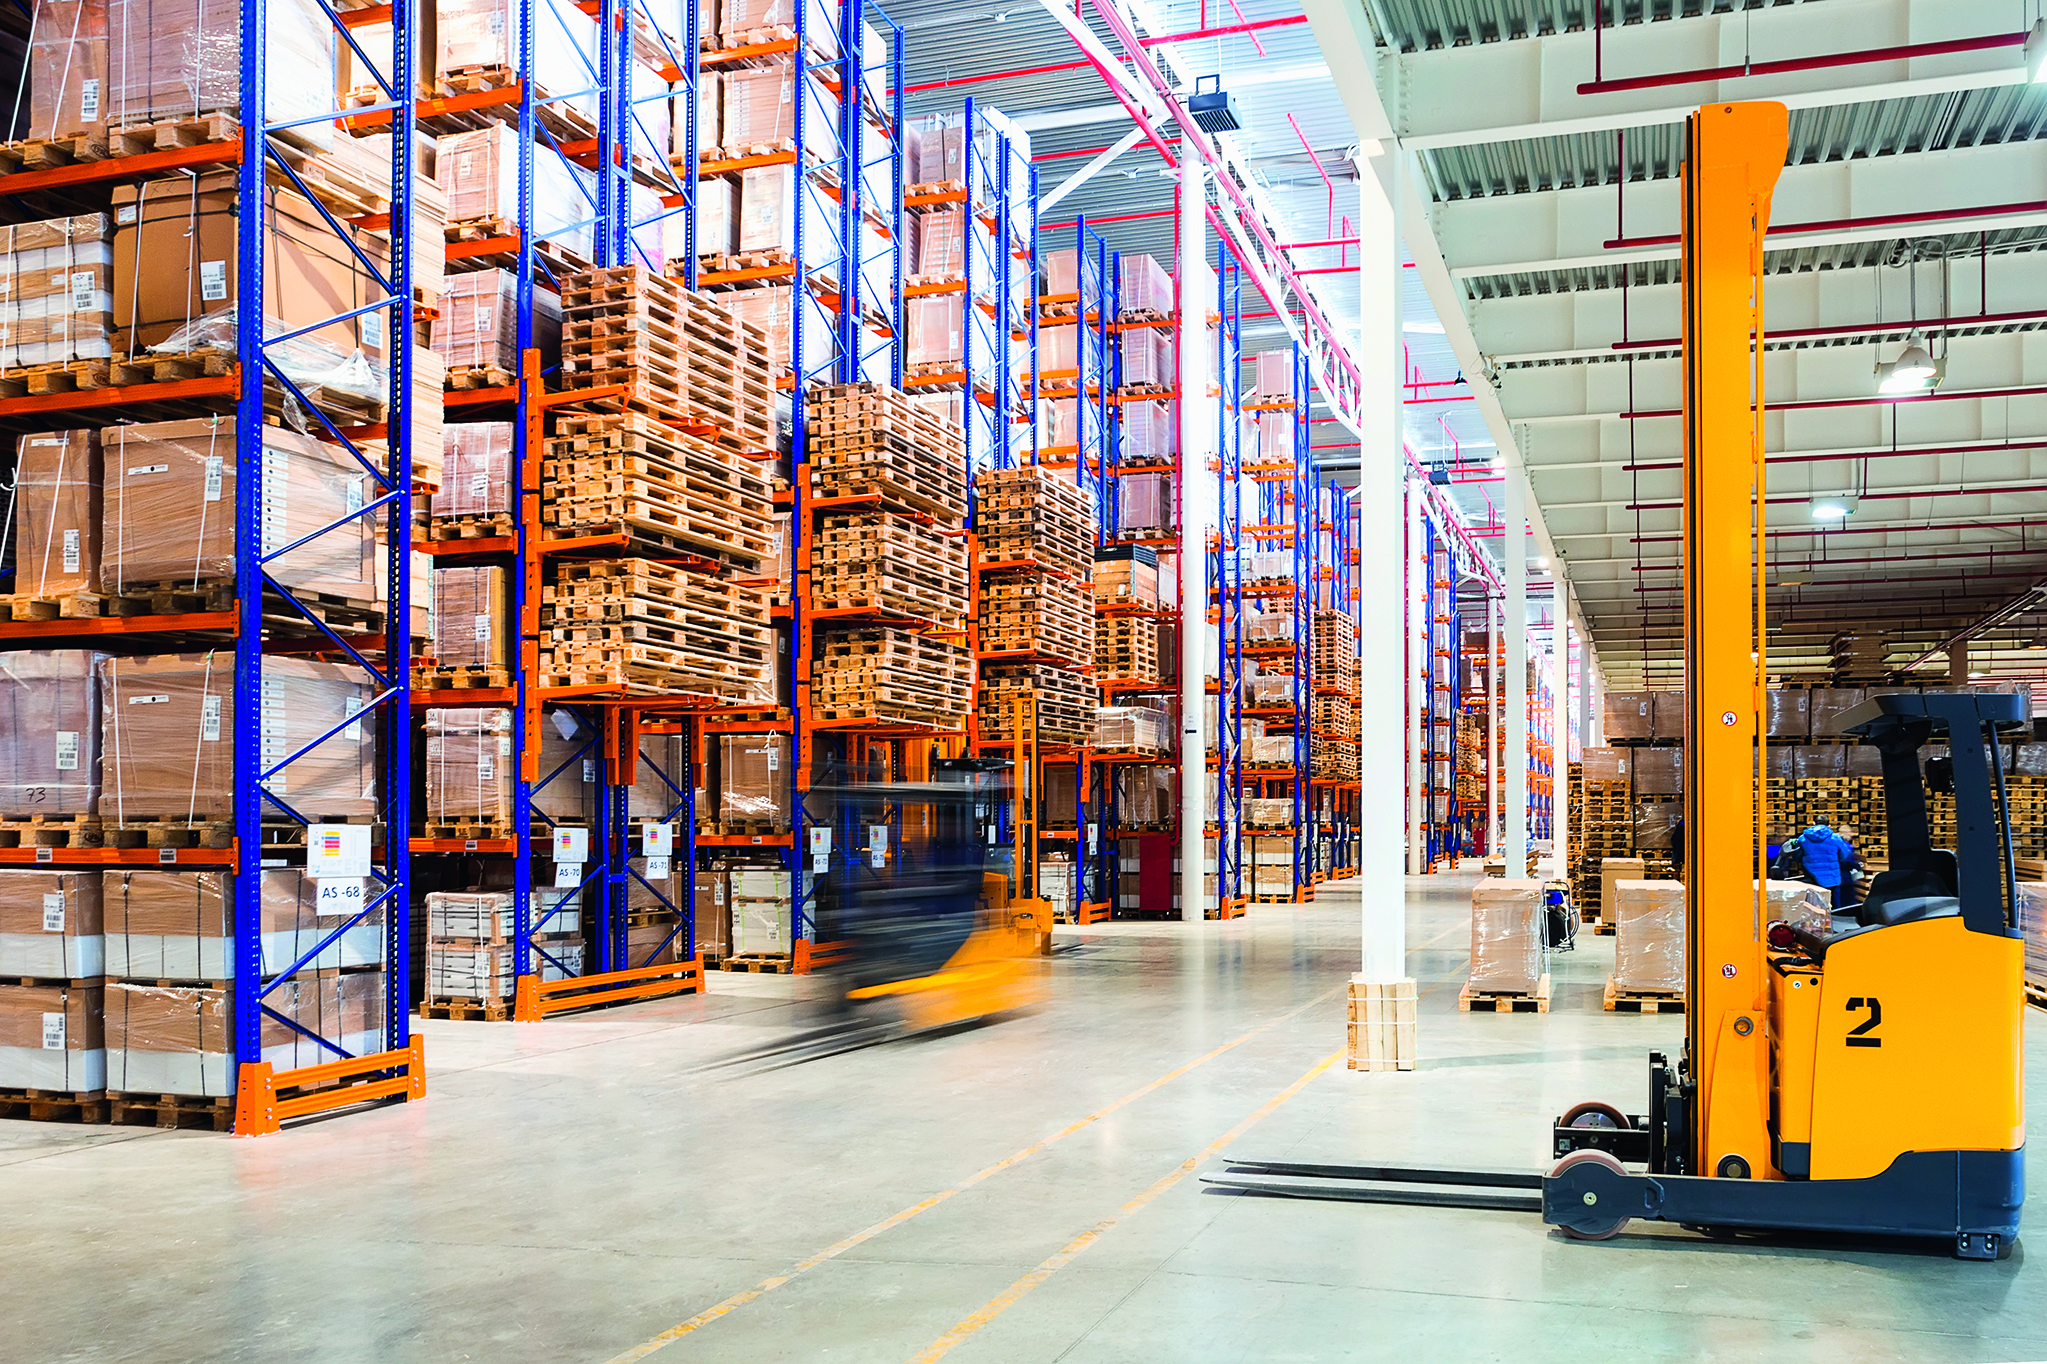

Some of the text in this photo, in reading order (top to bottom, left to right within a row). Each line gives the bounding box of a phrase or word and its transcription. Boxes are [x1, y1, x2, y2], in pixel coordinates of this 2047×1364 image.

[26, 787, 46, 803] 73
[649, 861, 658, 869] AS
[559, 868, 580, 876] AS -70
[322, 886, 360, 898] AS -68
[1846, 997, 1881, 1047] 2
